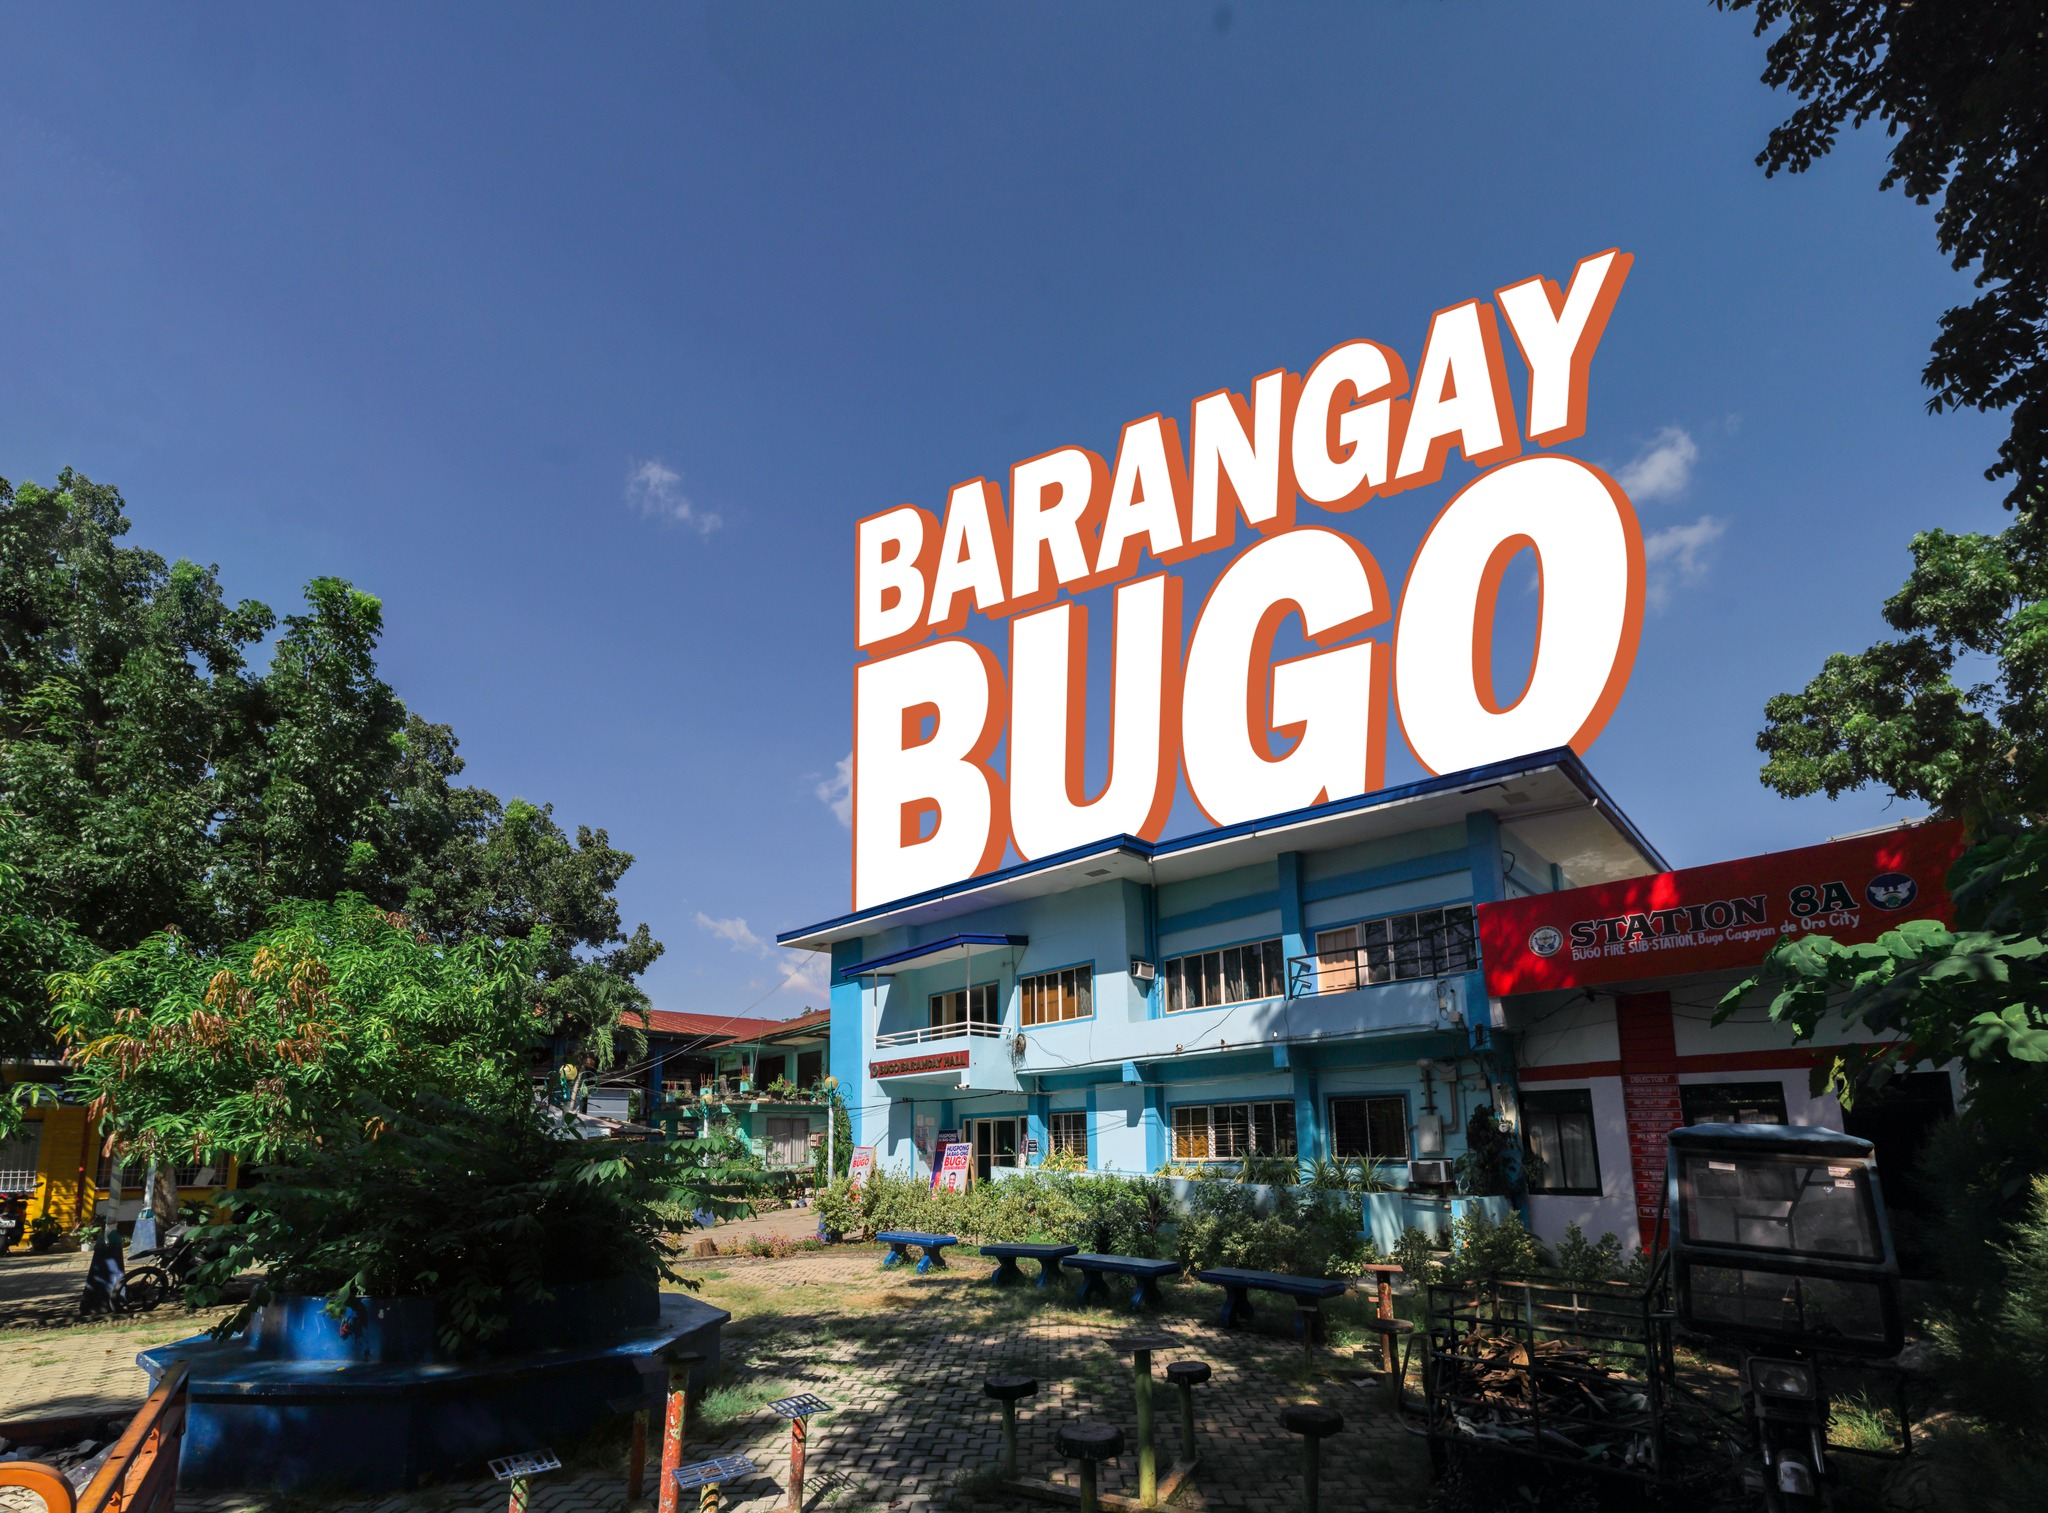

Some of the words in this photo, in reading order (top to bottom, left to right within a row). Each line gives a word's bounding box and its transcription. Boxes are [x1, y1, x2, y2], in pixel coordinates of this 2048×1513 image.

[1570, 895, 1767, 949] STATION
[1789, 881, 1860, 918] 8A
[1604, 943, 1626, 957] FIRE
[1698, 932, 1724, 945] Bugo
[1726, 926, 1776, 943] Cagayan
[1780, 920, 1797, 933] de
[1801, 916, 1826, 931] Oro
[1829, 911, 1860, 928] City
[880, 1063, 899, 1075] BUGO
[901, 1058, 942, 1072] BARANGAY
[943, 1055, 966, 1067] HALL
[1630, 1075, 1669, 1083] DIRECTORY
[852, 1157, 869, 1168] BUGO
[944, 1156, 967, 1166] BUGO
